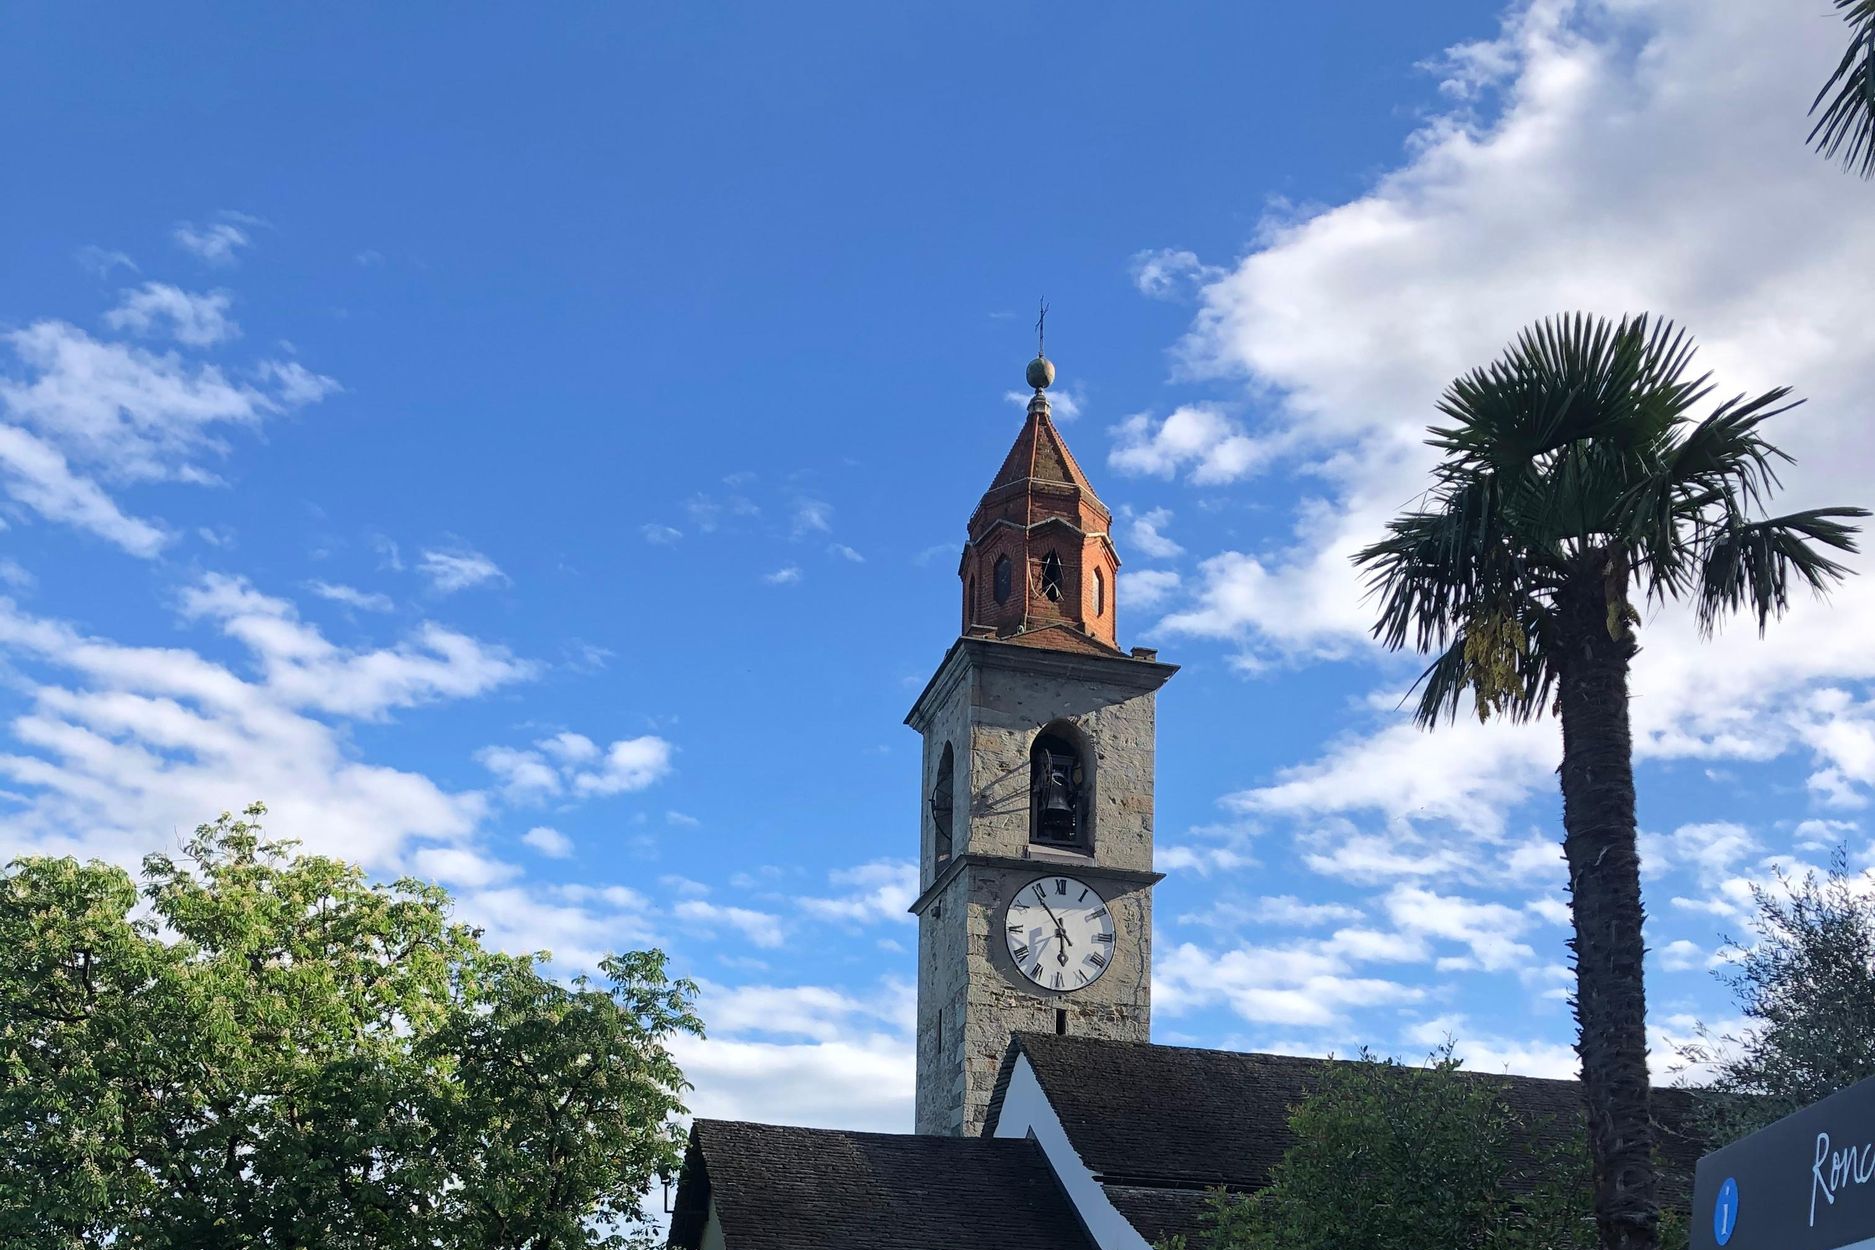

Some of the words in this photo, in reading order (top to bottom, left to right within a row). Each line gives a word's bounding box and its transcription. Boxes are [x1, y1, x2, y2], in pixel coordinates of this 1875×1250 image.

[1055, 879, 1067, 895] XII
[1078, 889, 1088, 902] I
[1097, 933, 1113, 943] III
[1809, 1132, 1875, 1227] Ronc
